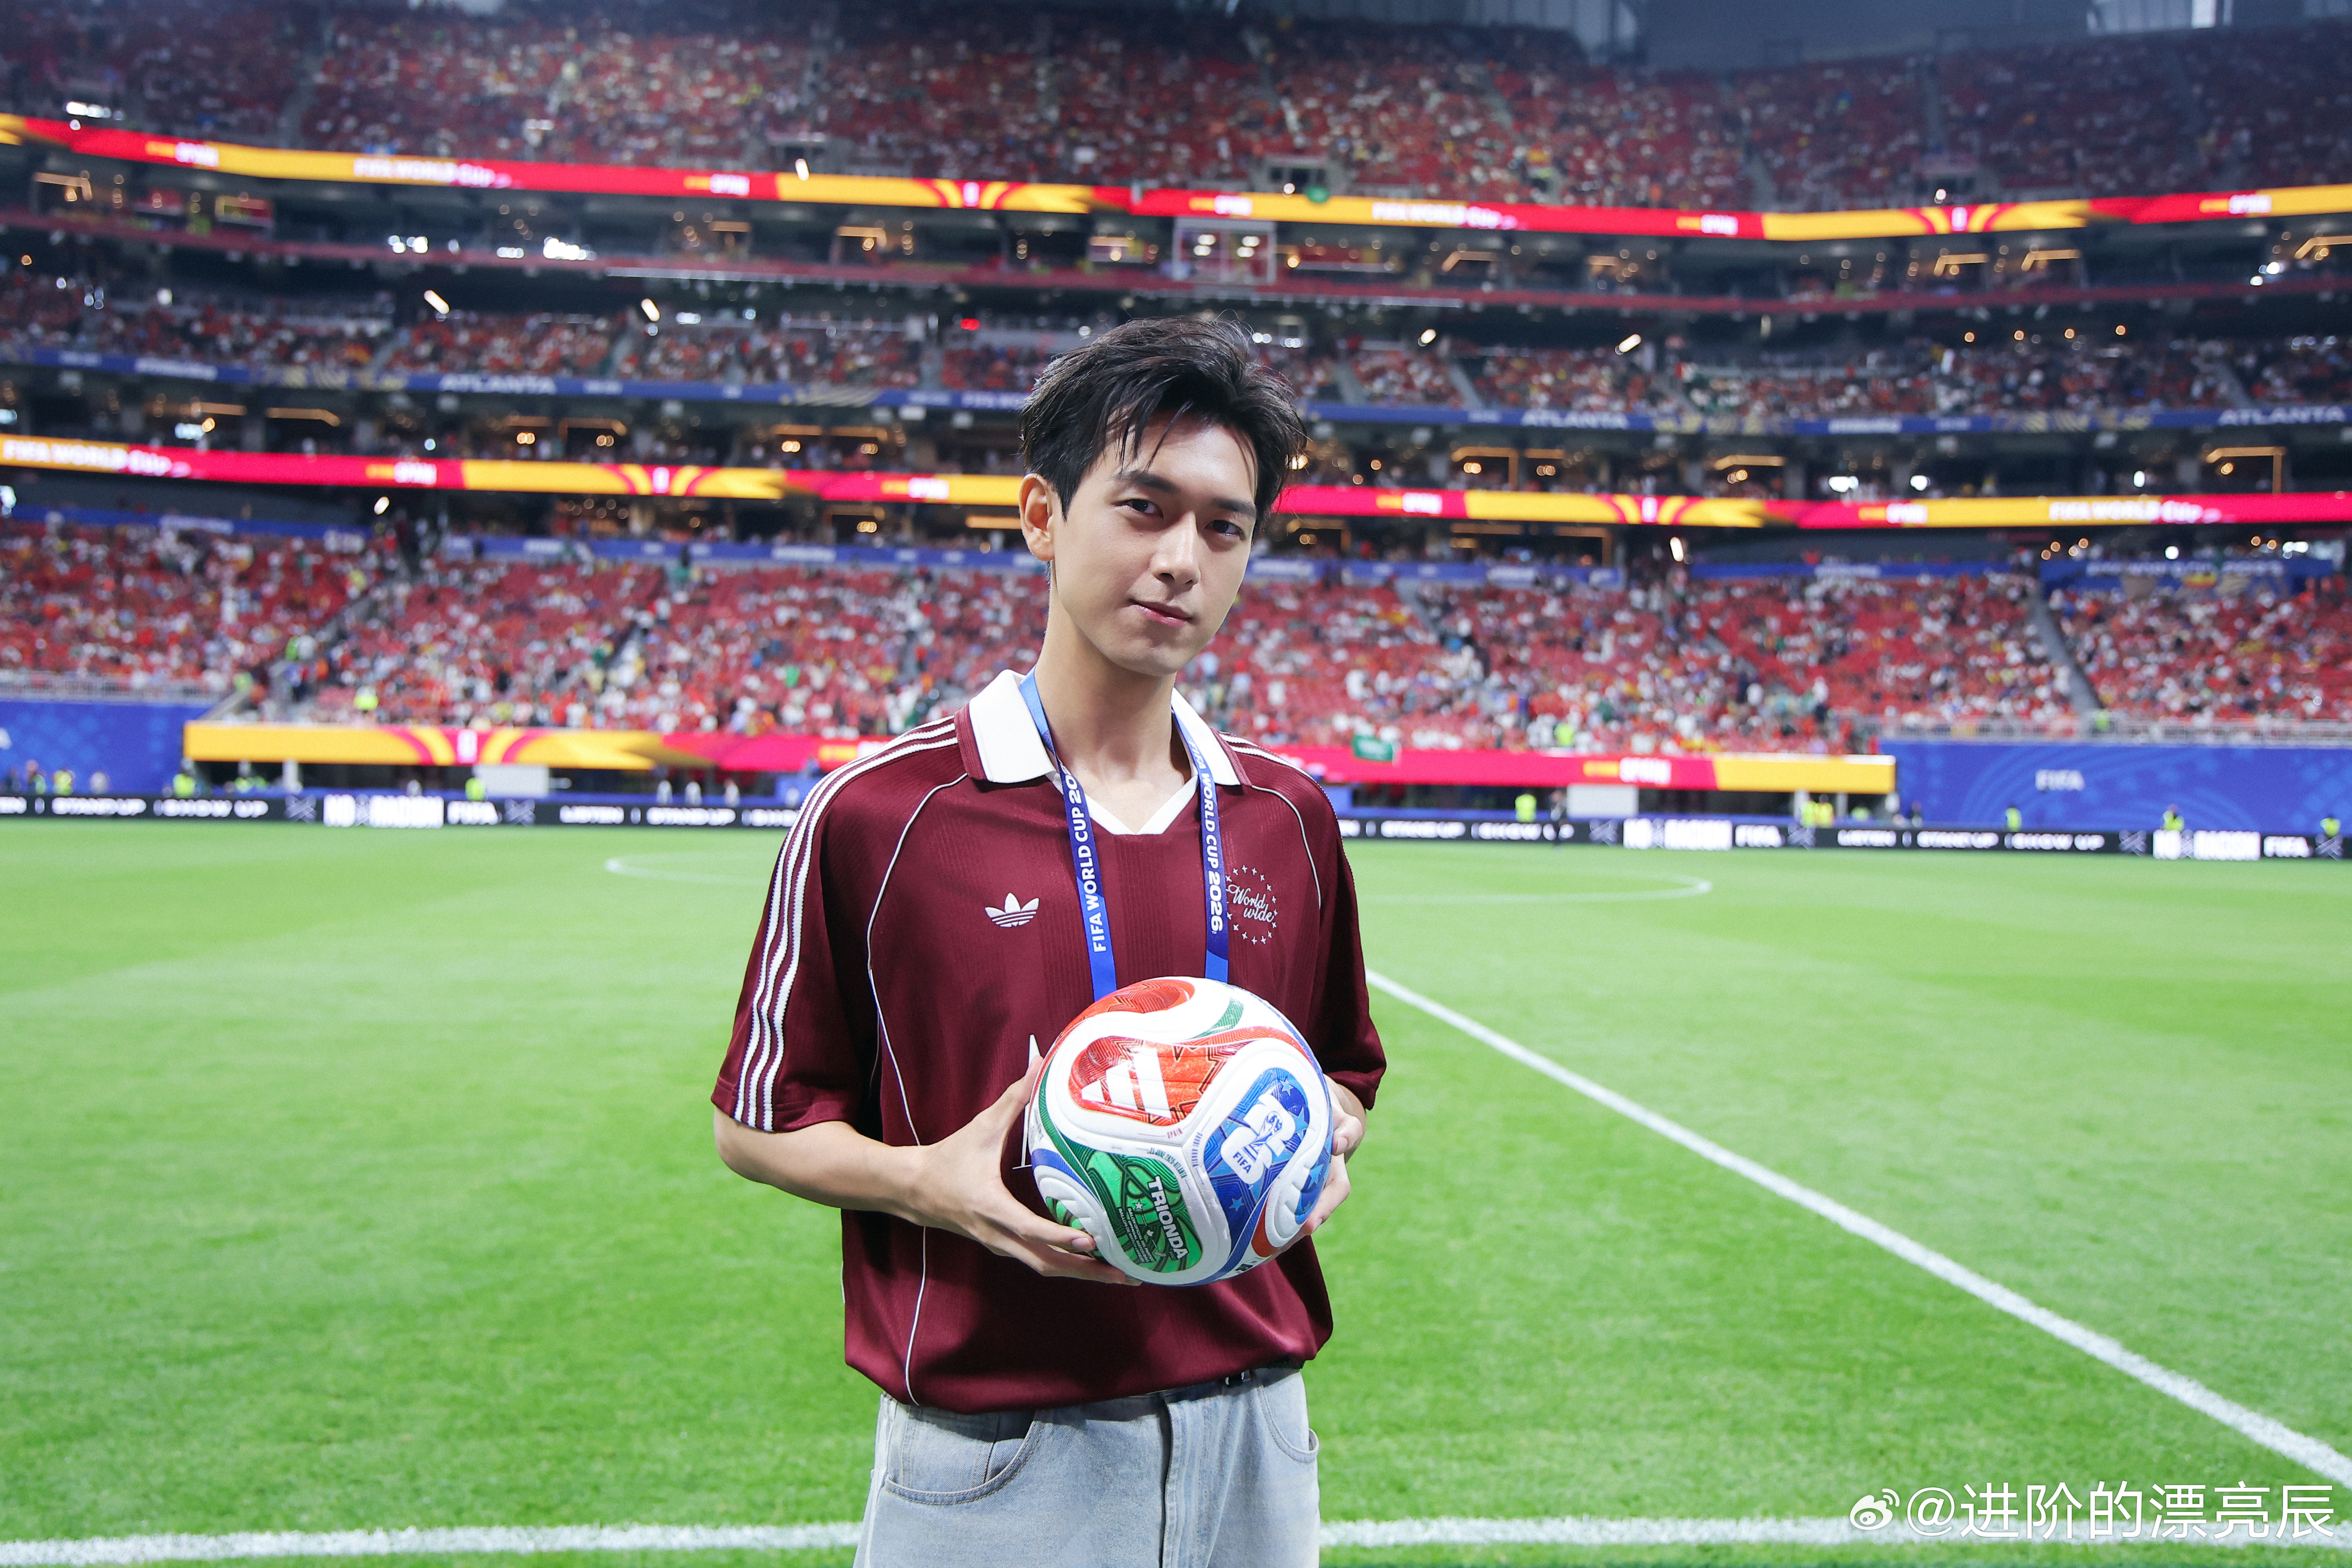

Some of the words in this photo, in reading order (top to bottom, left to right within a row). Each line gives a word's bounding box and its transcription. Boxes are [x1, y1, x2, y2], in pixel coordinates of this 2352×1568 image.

[440, 372, 557, 394] ATLANTA
[2217, 406, 2346, 425] ATLANTA
[1188, 740, 1207, 769] FIFA
[1060, 762, 1082, 804] 202
[2036, 769, 2085, 790] FIFA
[1201, 773, 1216, 832] WORLD
[1071, 806, 1089, 843] CUP
[1205, 833, 1219, 869] CUP
[1078, 844, 1101, 911] WORLD
[1208, 870, 1223, 931] 2026
[1225, 884, 1266, 909] World
[1243, 904, 1274, 922] wide
[1091, 912, 1107, 953] FIFA
[1167, 1128, 1183, 1139] SPAIN
[1193, 1132, 1203, 1147] SAUDI
[1233, 1151, 1252, 1174] FIFA
[1118, 1208, 1128, 1227] BALLON
[1149, 1176, 1189, 1259] TRIONDA
